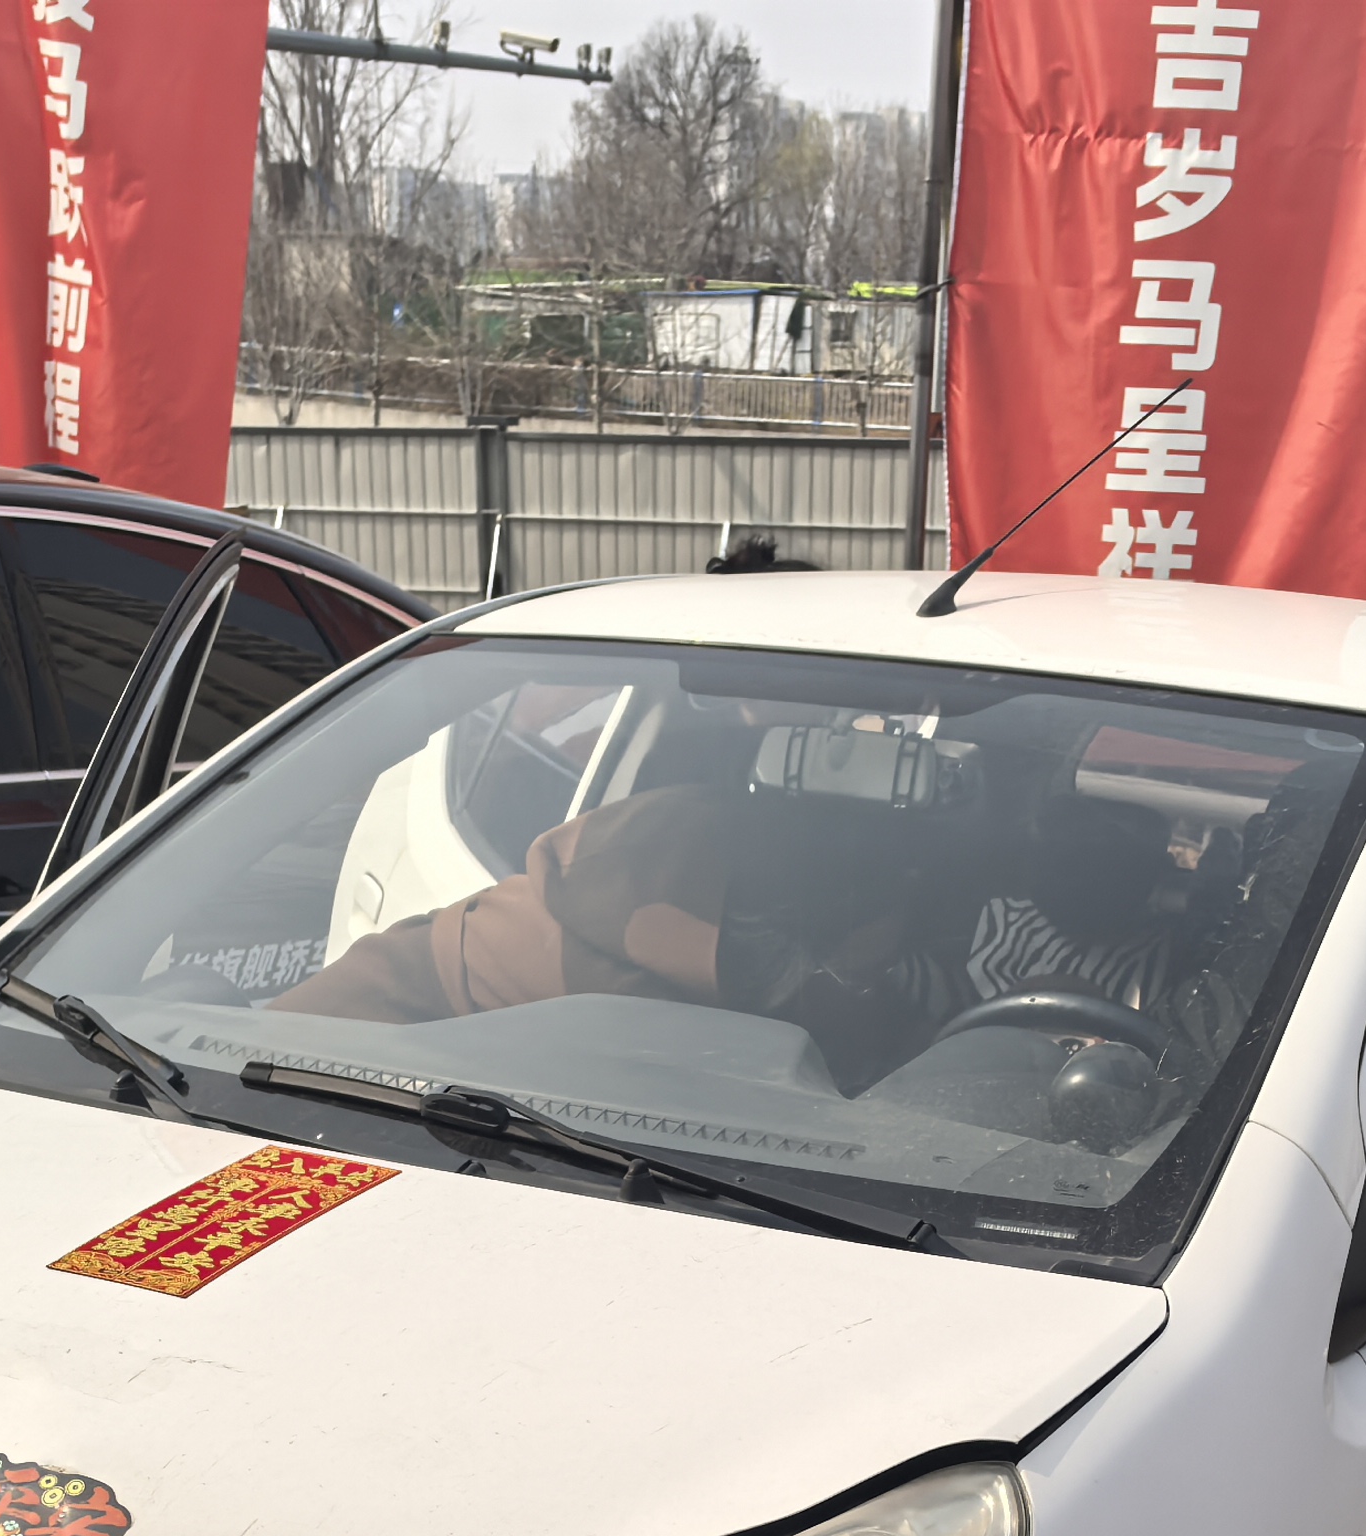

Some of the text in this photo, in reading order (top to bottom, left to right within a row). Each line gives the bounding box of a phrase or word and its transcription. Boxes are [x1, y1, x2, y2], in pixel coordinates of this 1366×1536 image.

[1097, 0, 1260, 581] 吉岁马呈祥
